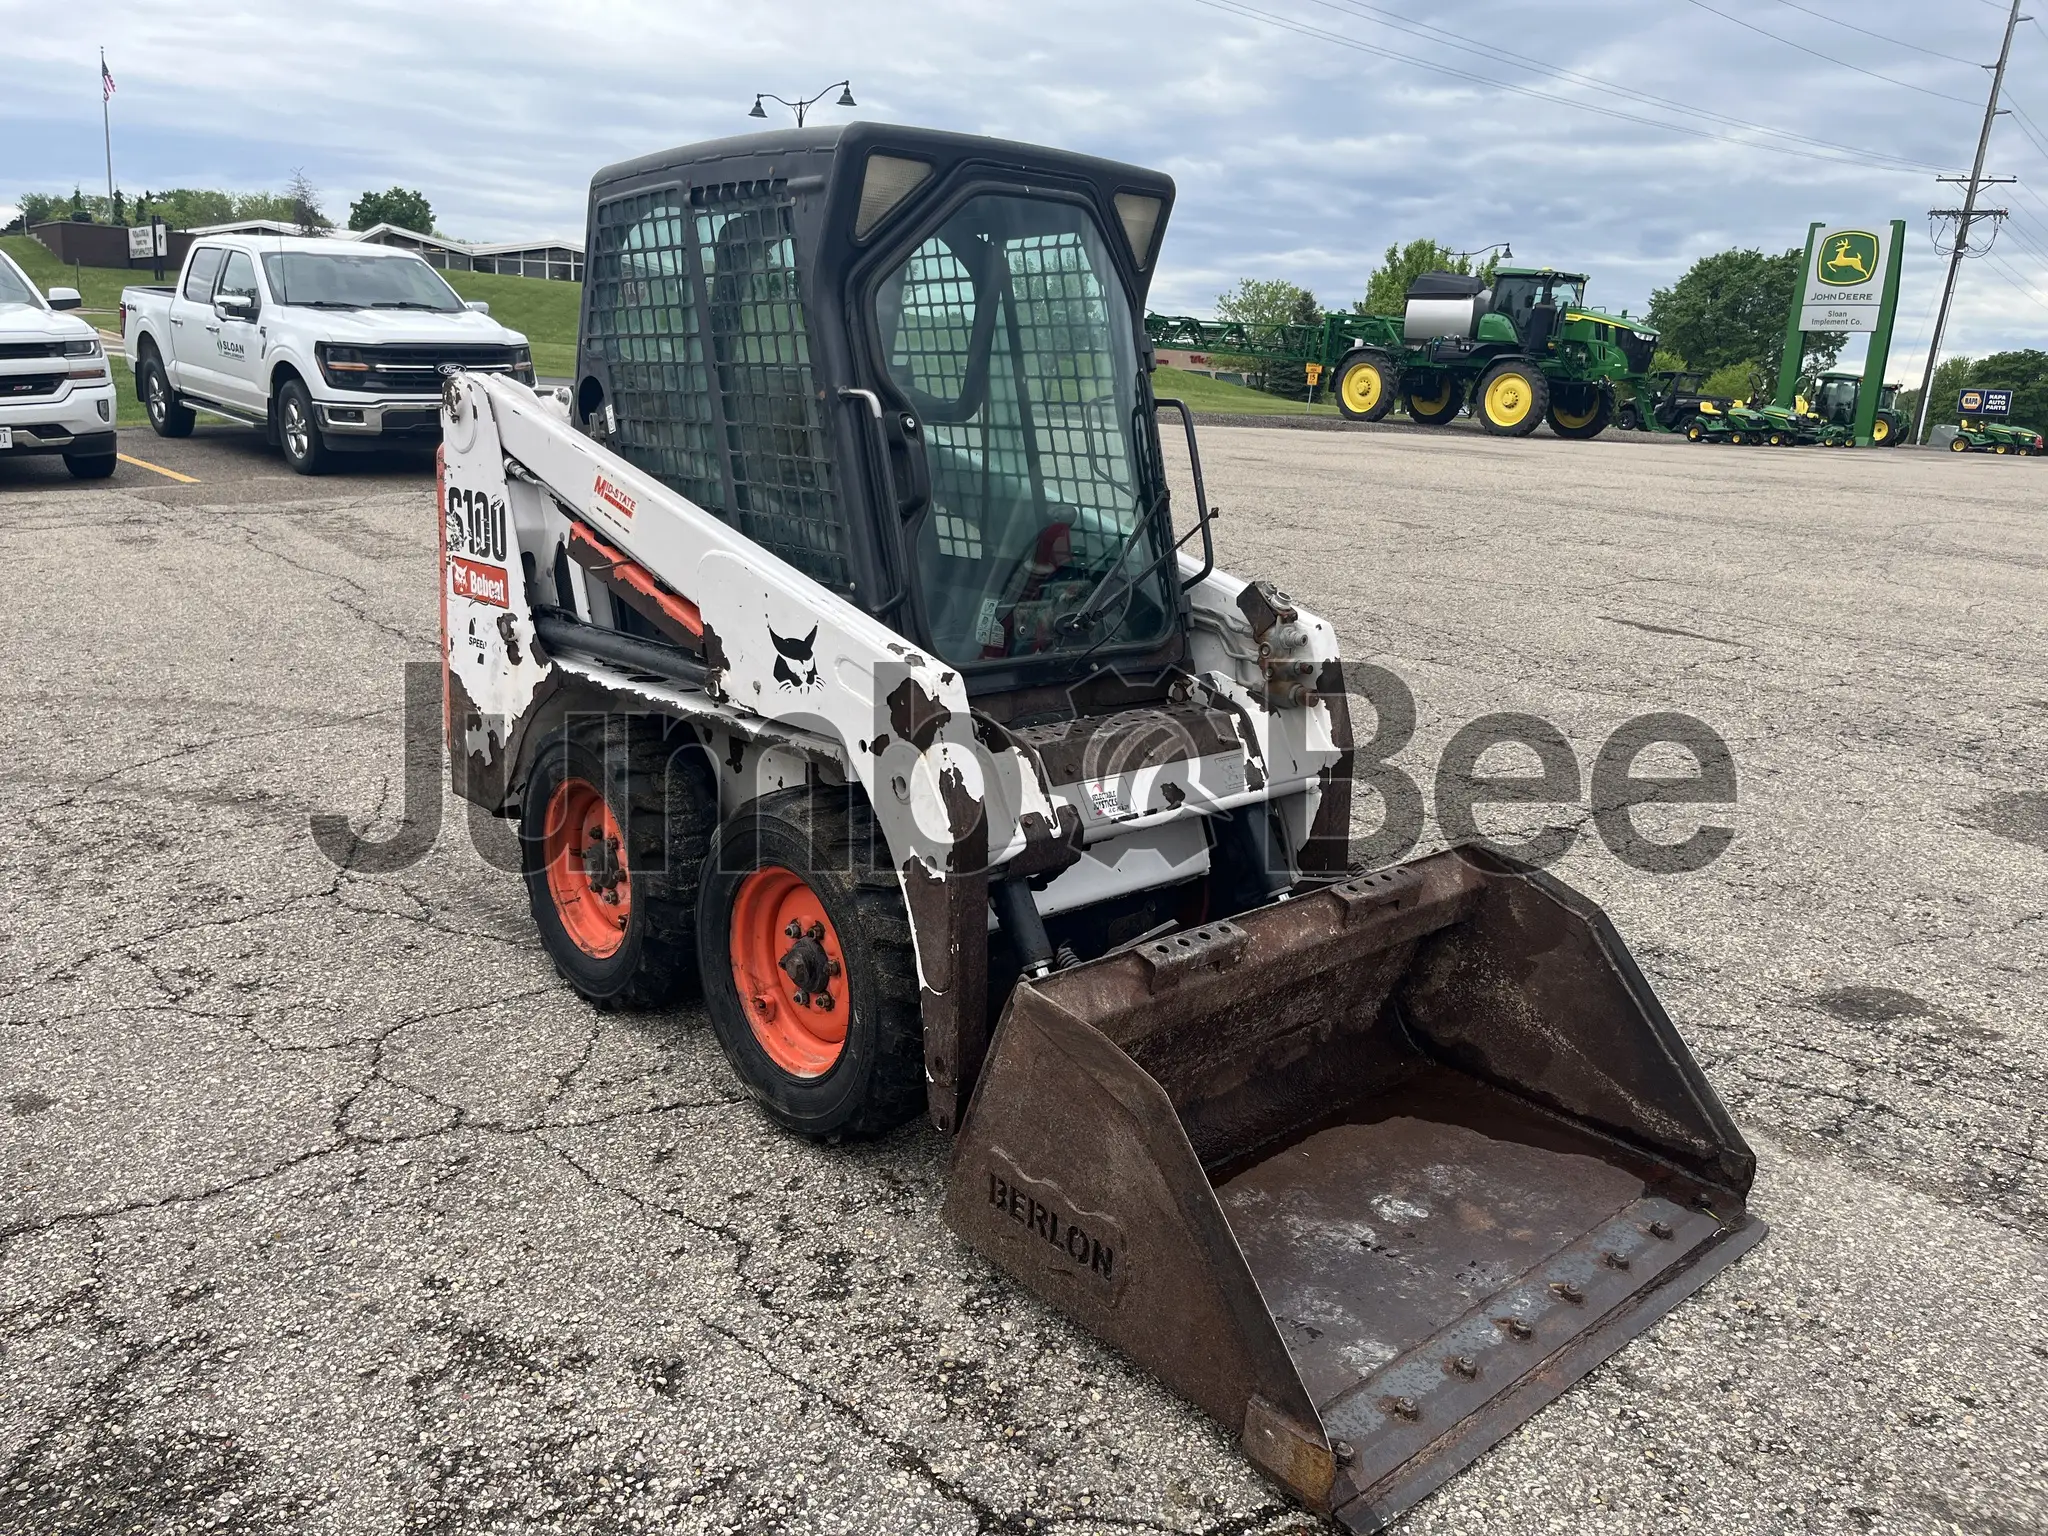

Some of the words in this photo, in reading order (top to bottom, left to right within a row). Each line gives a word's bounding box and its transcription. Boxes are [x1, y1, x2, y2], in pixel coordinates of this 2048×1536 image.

[1811, 292, 1837, 301] JOHN
[1838, 292, 1873, 301] DEERE
[1828, 310, 1848, 318] Sloan
[1850, 318, 1862, 326] Co.
[223, 340, 244, 354] SLOAN
[594, 475, 636, 511] MID-STATE
[446, 487, 507, 562] S100
[470, 570, 505, 603] Bobcat
[989, 1172, 1113, 1282] BERLON
